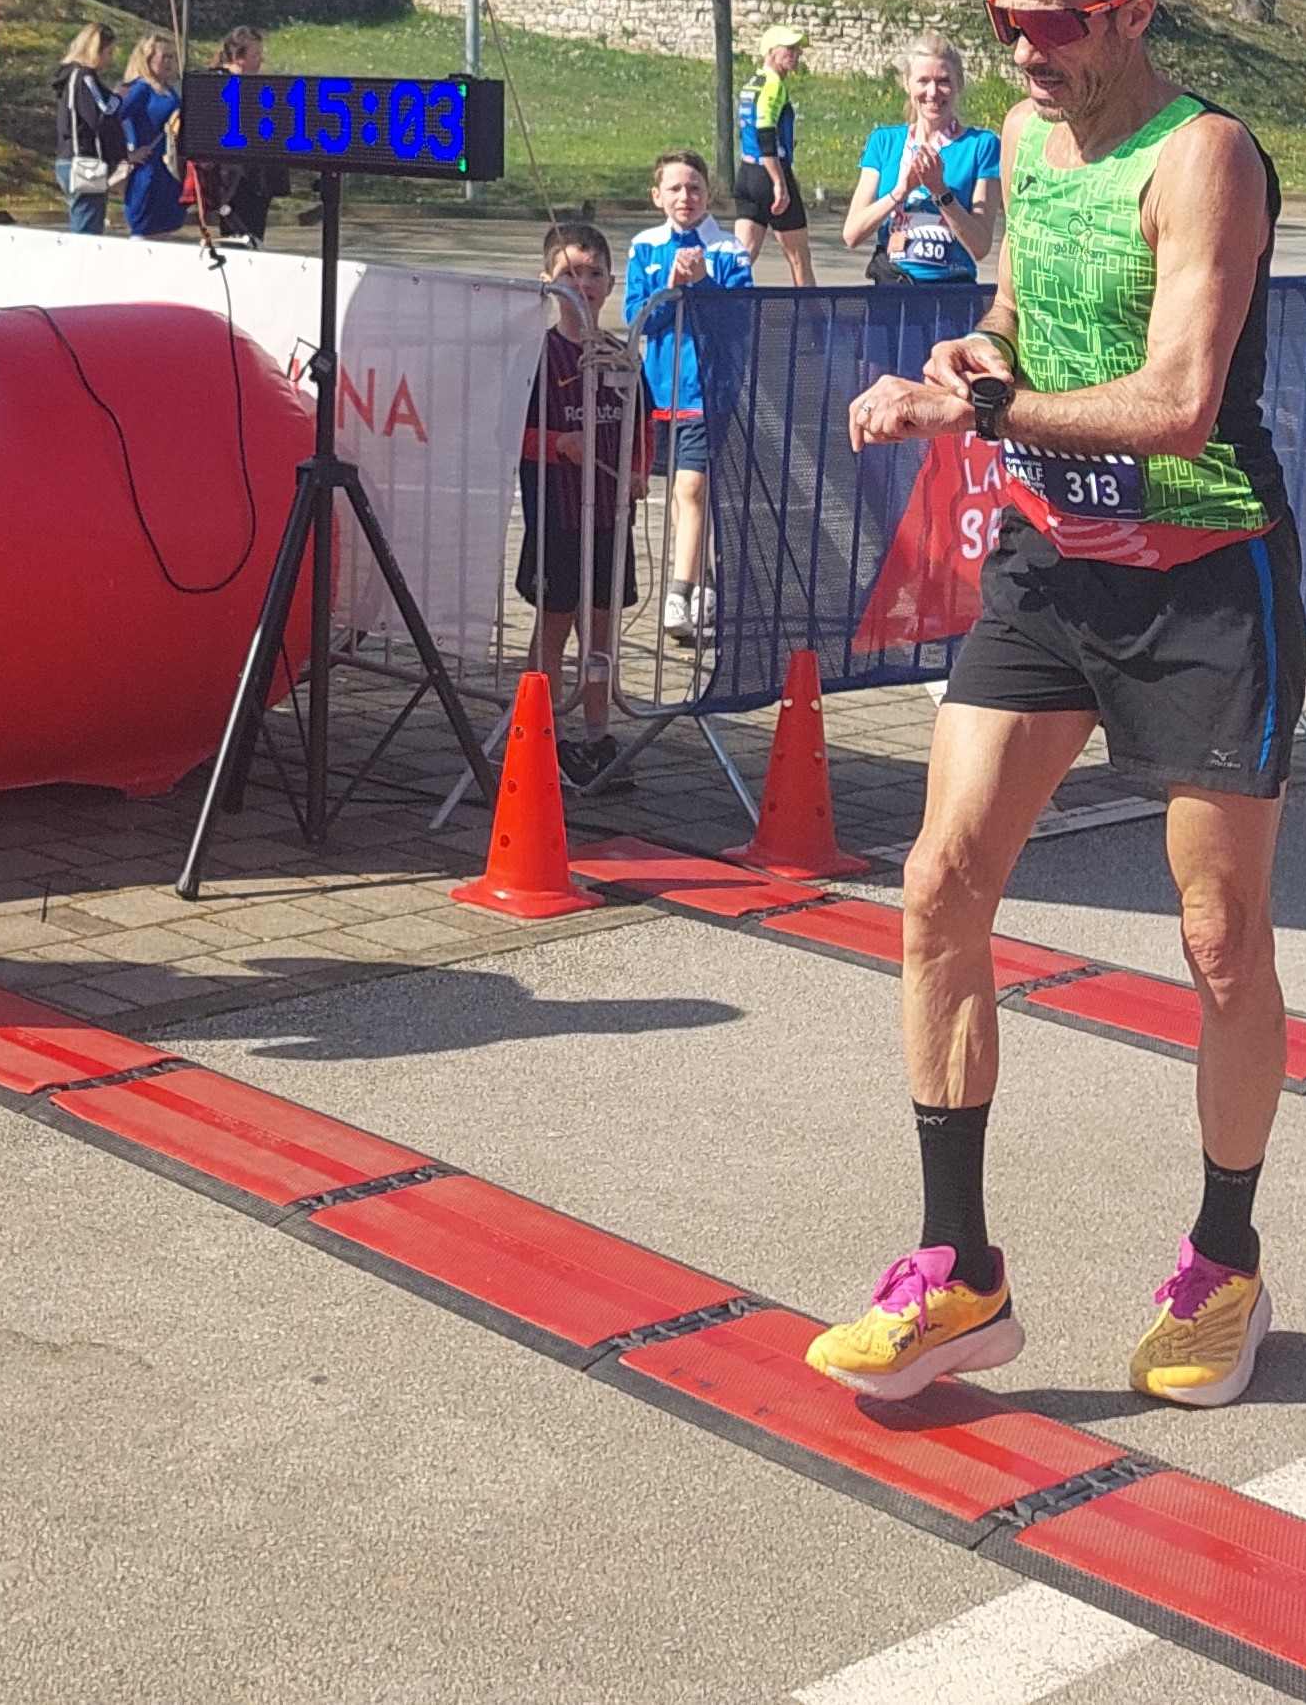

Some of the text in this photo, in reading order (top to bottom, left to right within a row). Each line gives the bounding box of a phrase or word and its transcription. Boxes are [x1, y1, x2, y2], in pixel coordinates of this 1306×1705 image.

[220, 75, 465, 161] 1:15:03
[913, 241, 945, 260] 430
[1065, 471, 1120, 507] 313
